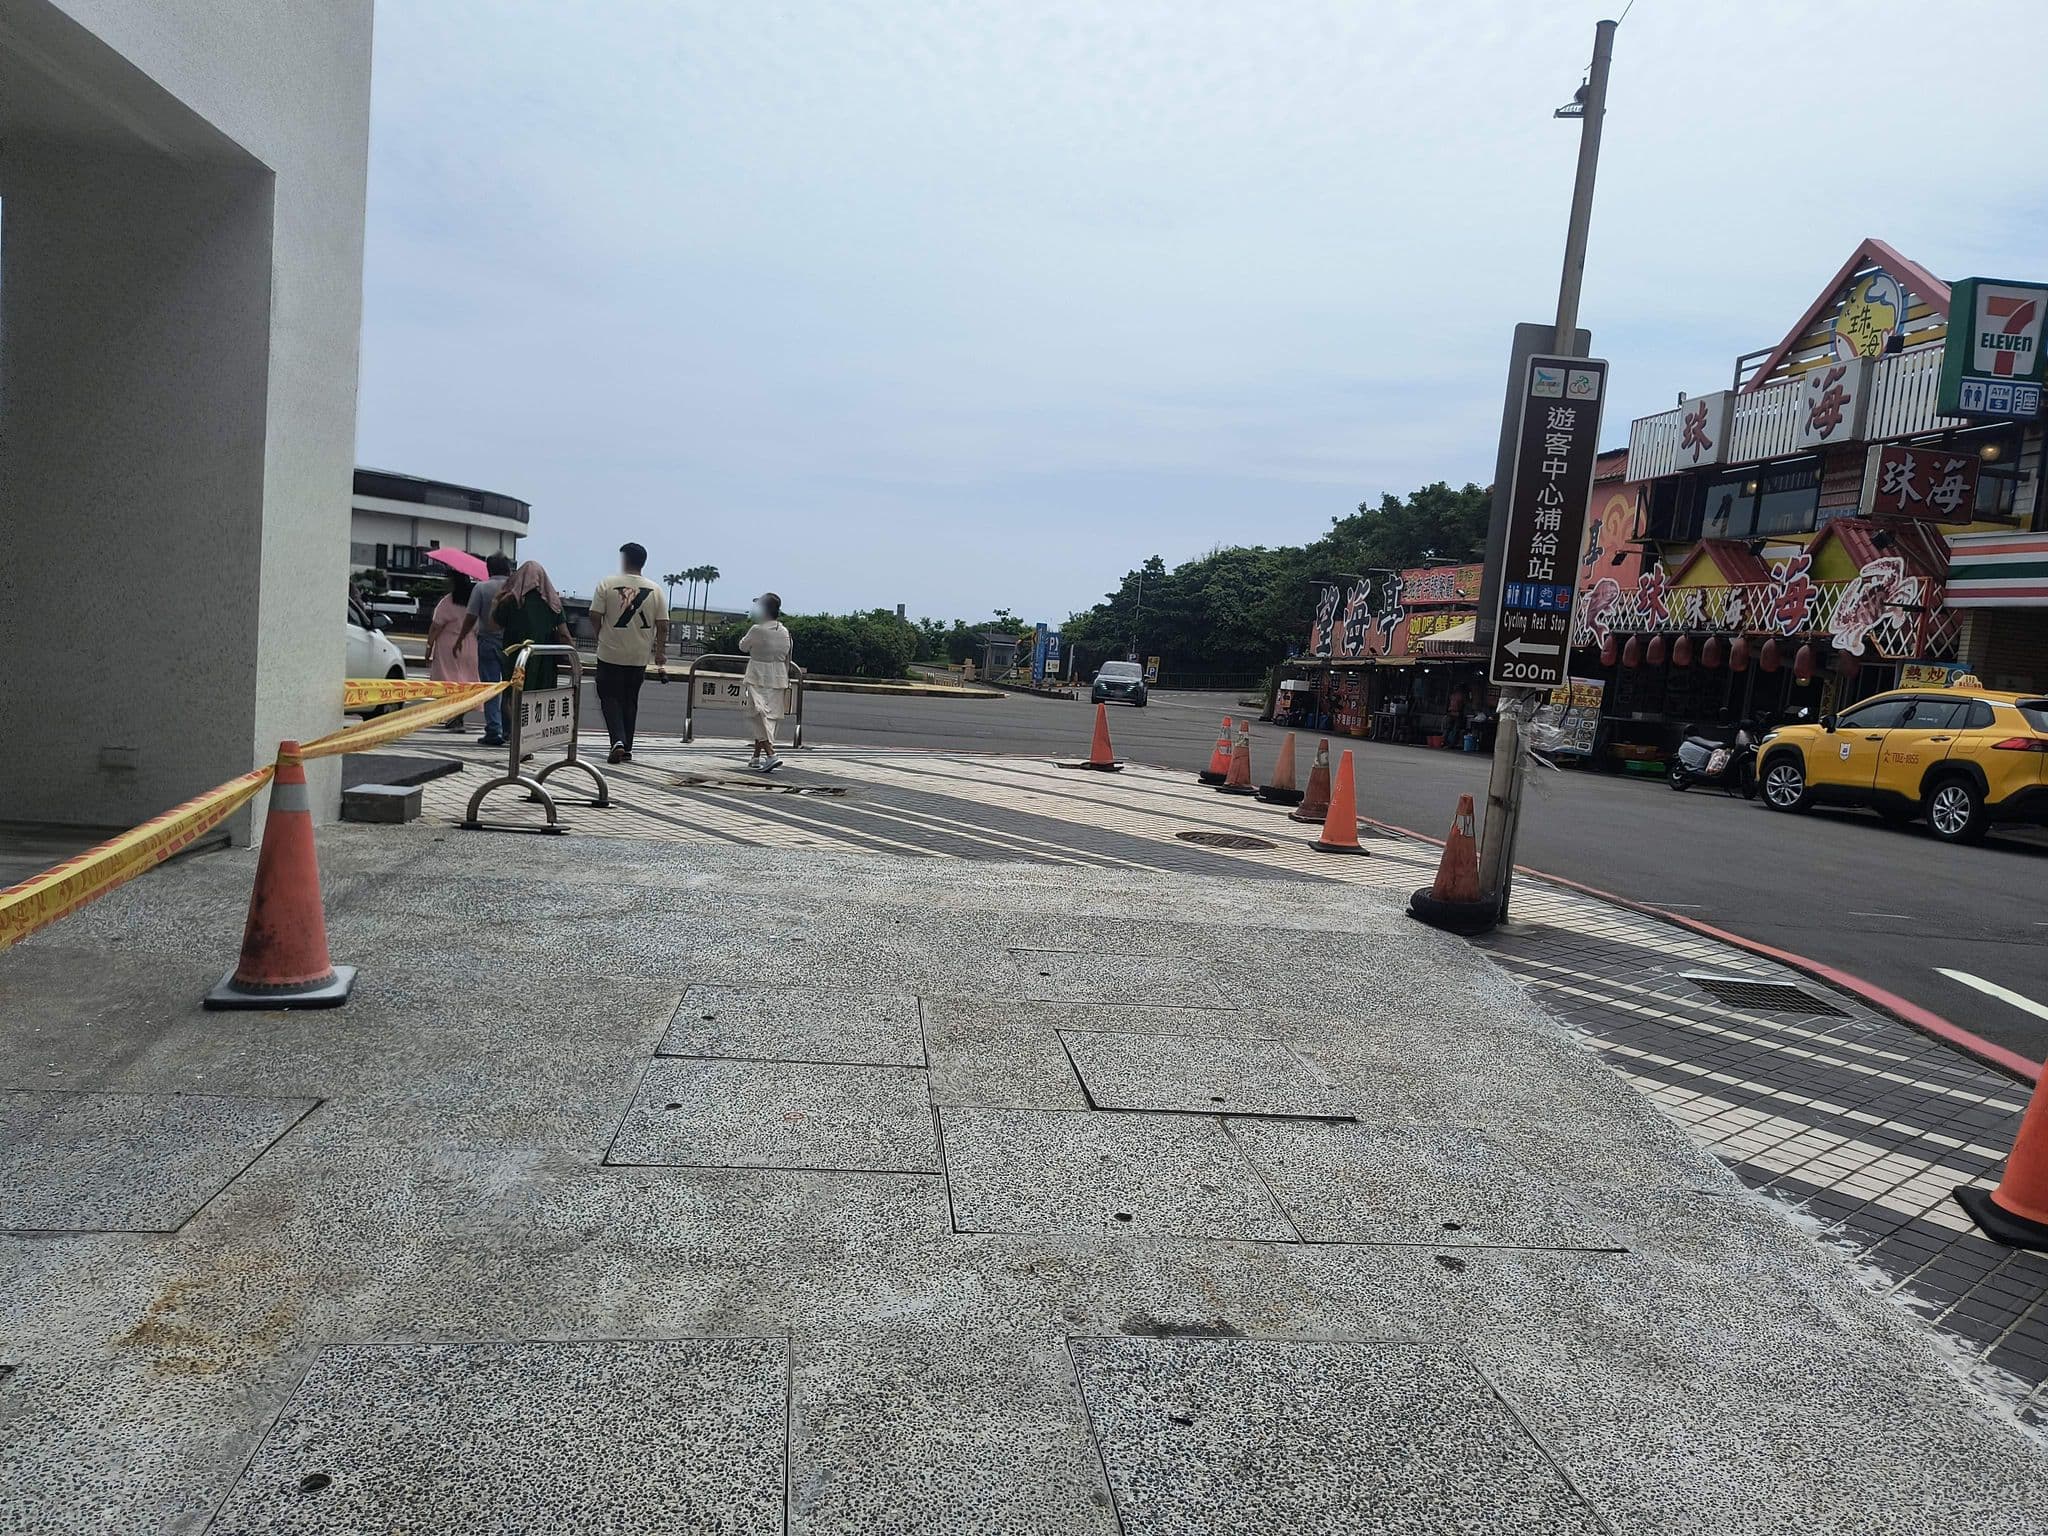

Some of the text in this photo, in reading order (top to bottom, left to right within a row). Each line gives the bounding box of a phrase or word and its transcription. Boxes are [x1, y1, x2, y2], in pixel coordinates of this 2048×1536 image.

[1847, 304, 1883, 359] 珠海
[1991, 387, 2010, 398] ATM
[1680, 365, 1852, 464] 珠 海
[1527, 405, 1577, 582] 遊客中心補給站
[1881, 452, 1971, 514] 珠海
[1316, 574, 1405, 657] 望海亭
[1504, 611, 1566, 635] Cycling Rest Stop
[1502, 661, 1557, 682] 200m
[1905, 665, 1946, 683] 熱炒
[702, 681, 748, 698] 請勿
[521, 696, 571, 728] 請勿停車
[541, 724, 570, 738] NO PARKING
